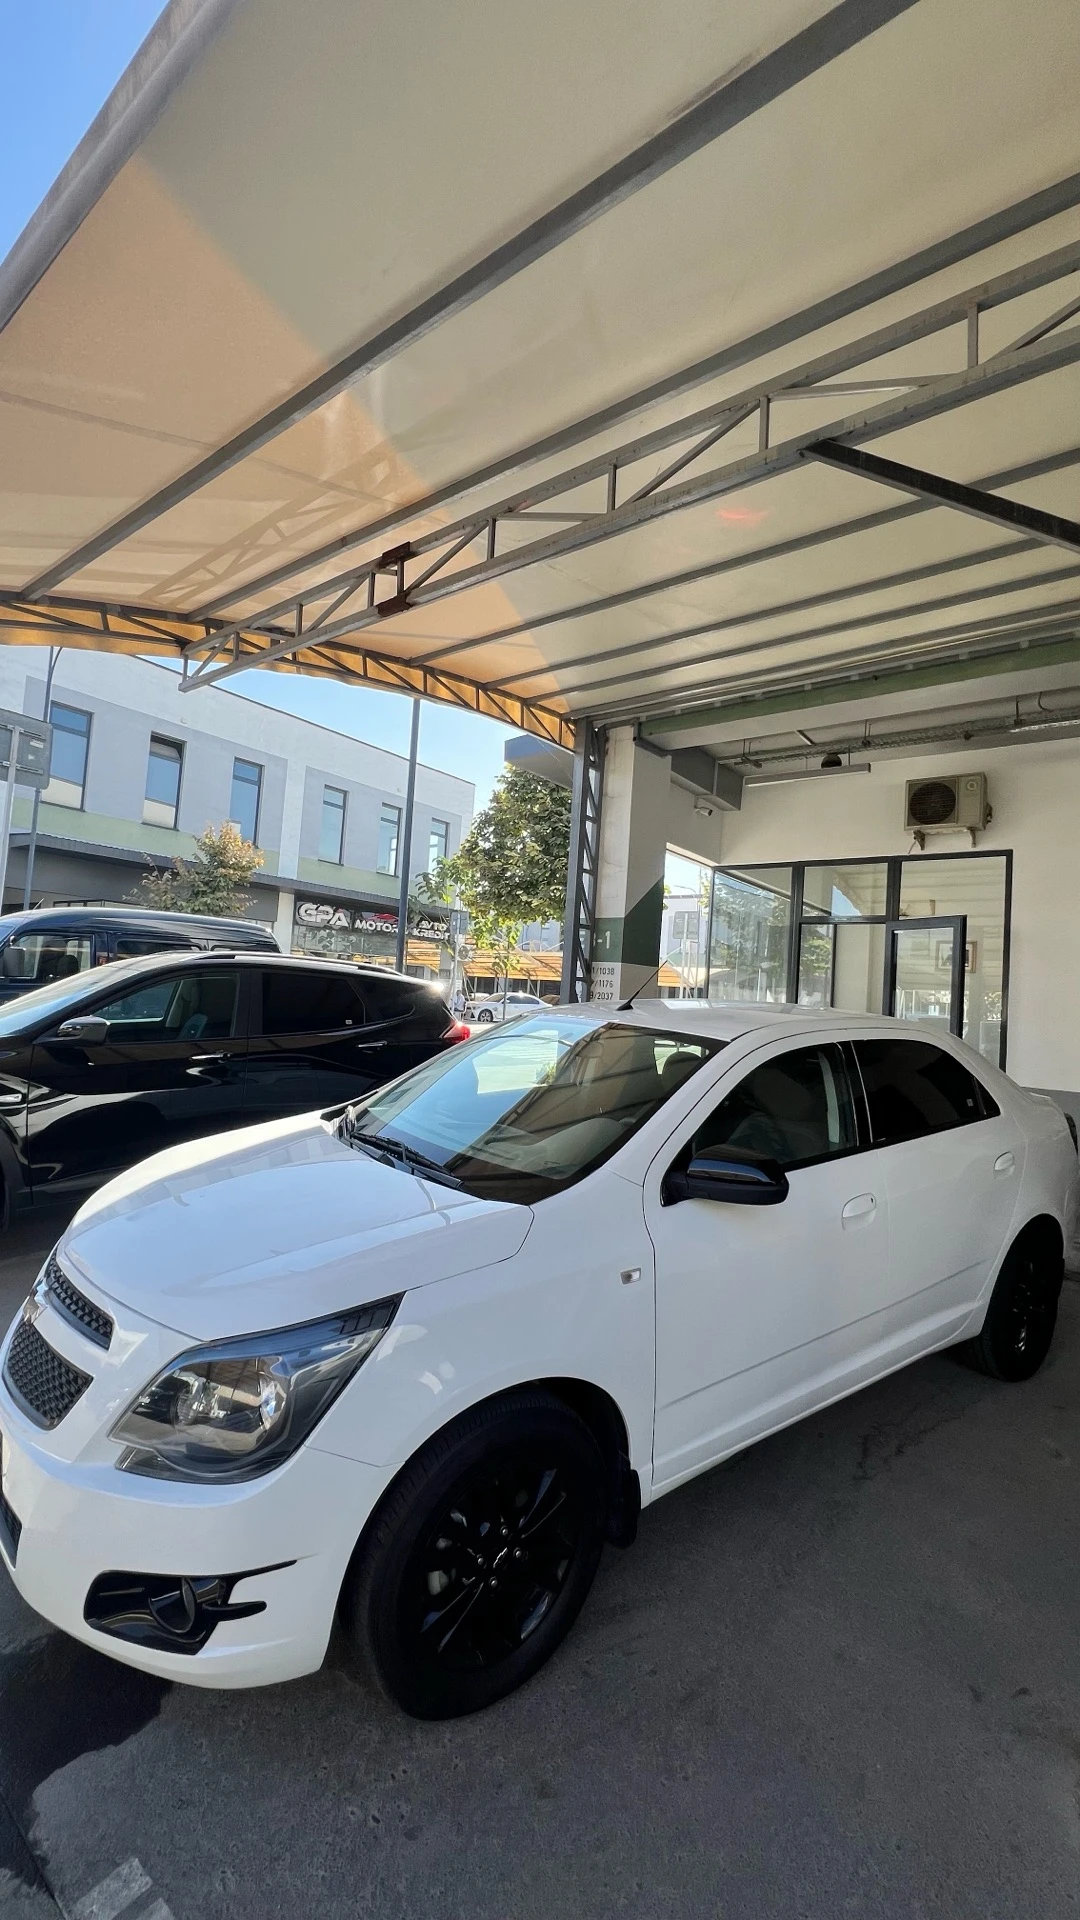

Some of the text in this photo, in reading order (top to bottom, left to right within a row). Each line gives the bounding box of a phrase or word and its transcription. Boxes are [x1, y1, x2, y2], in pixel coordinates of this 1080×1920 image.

[299, 903, 349, 927] GPA
[355, 919, 408, 934] MOTOR
[412, 928, 450, 940] KREDIT
